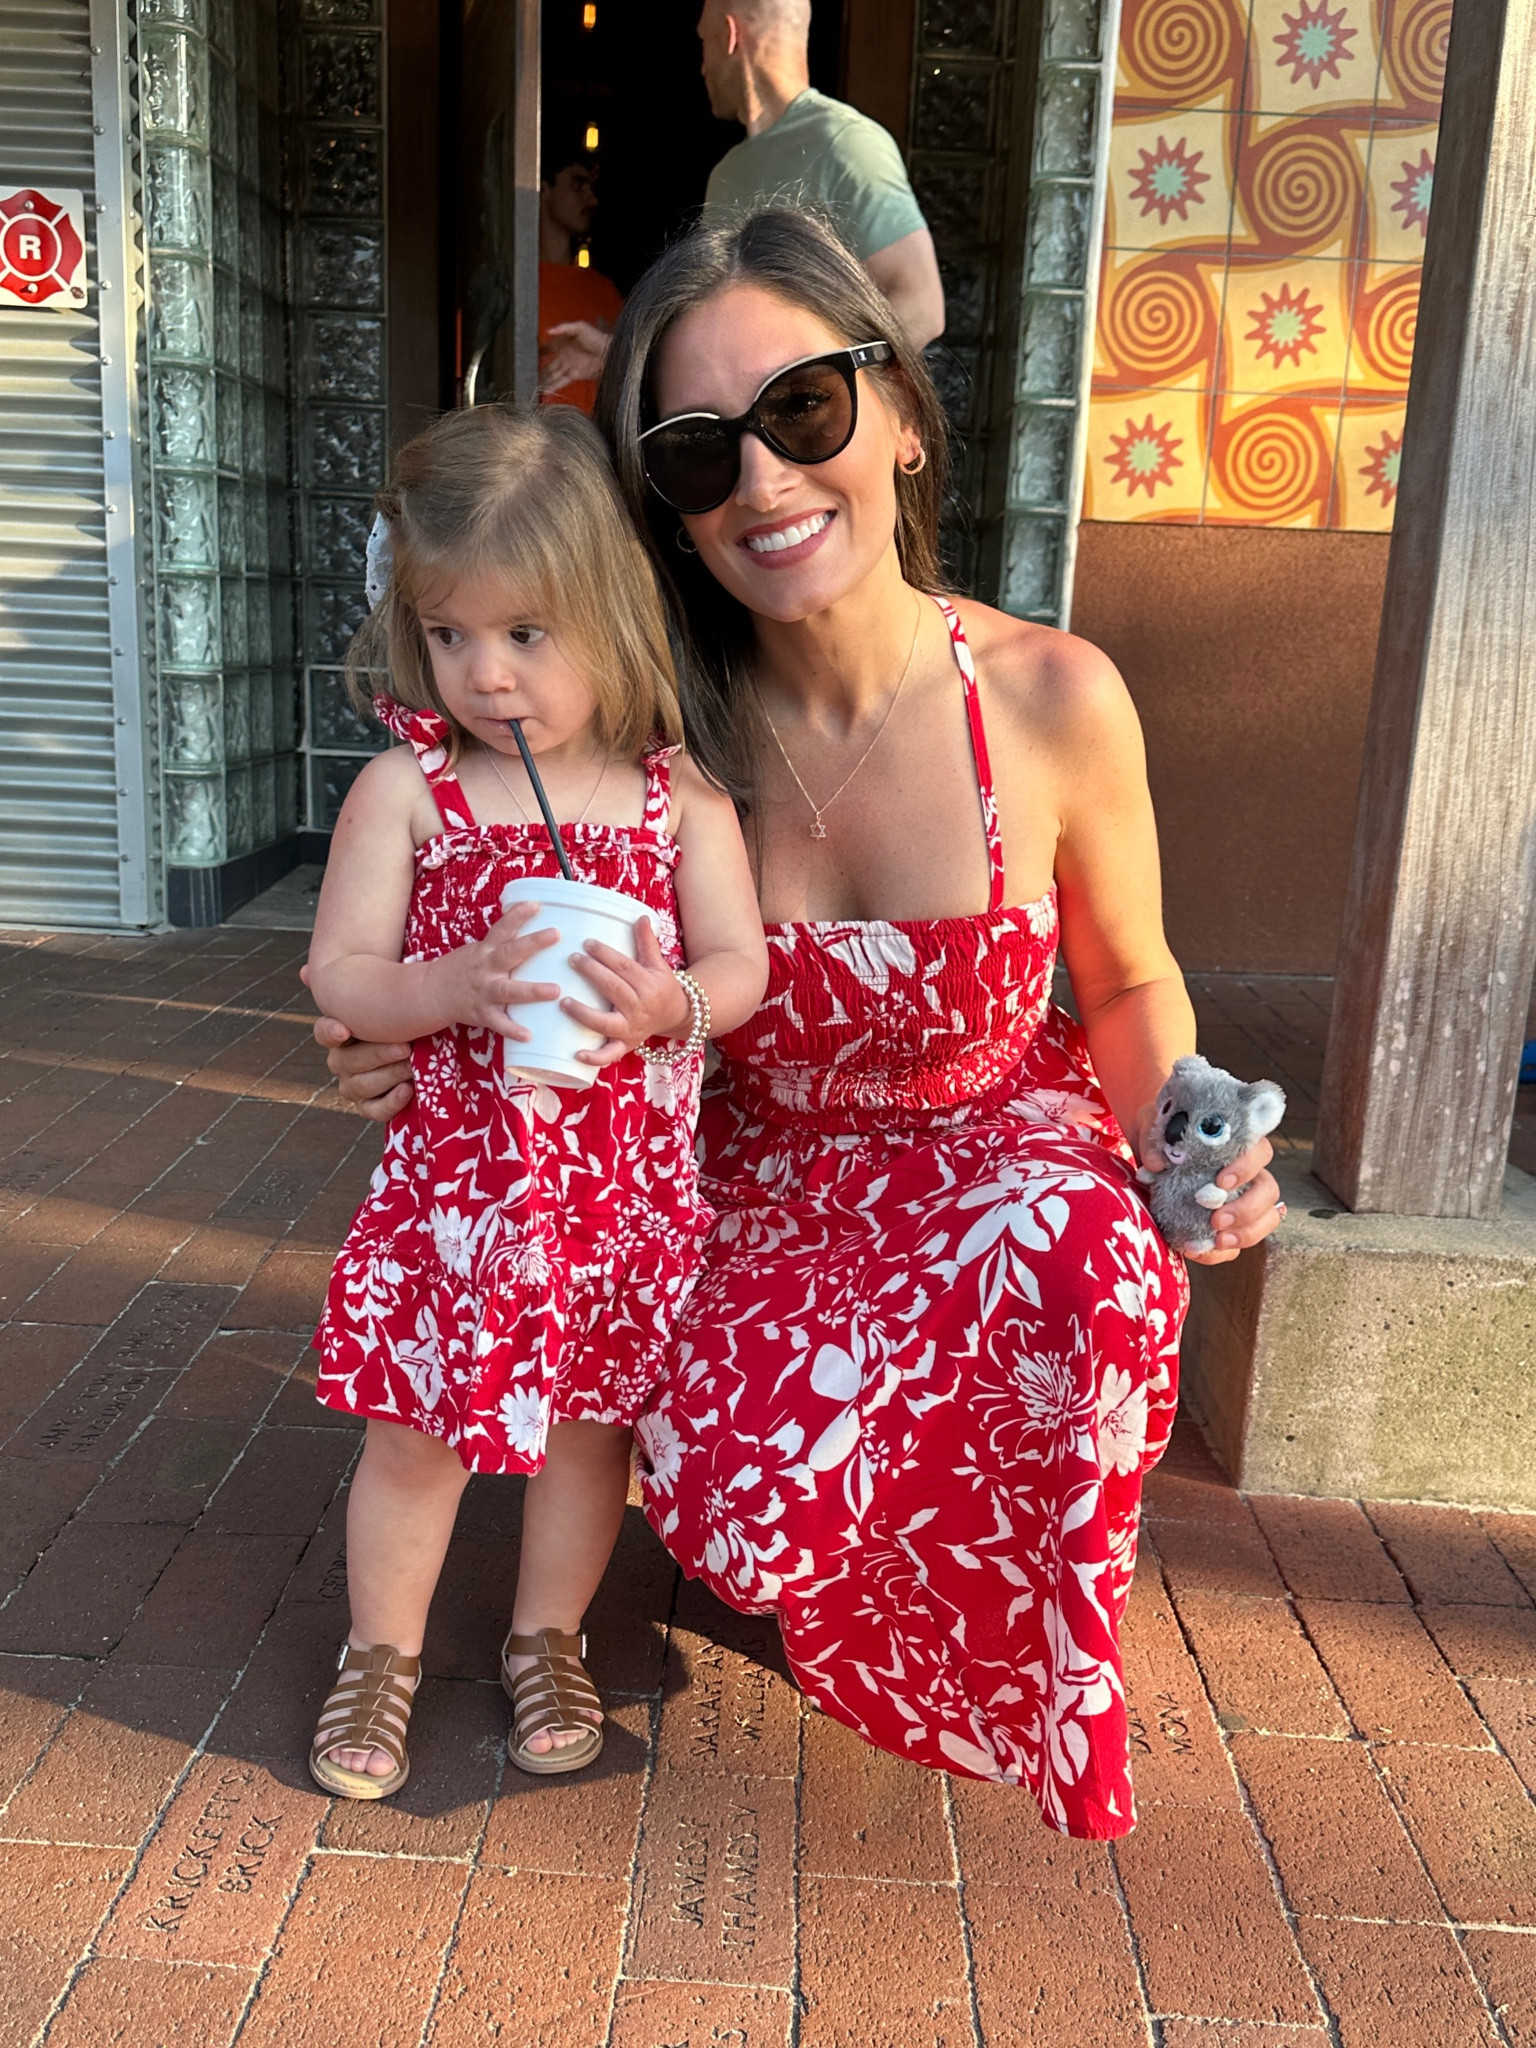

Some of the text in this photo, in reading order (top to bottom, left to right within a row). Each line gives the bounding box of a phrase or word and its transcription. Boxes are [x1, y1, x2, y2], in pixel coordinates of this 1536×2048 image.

[19, 234, 42, 261] R
[40, 1418, 75, 1450] AMY
[69, 1374, 151, 1453] HAZELWOOD
[690, 1678, 722, 1757] SARAH
[735, 1637, 766, 1742] WILLIAMS
[215, 1815, 282, 1893] BRICK
[670, 1837, 709, 1931] JAMES
